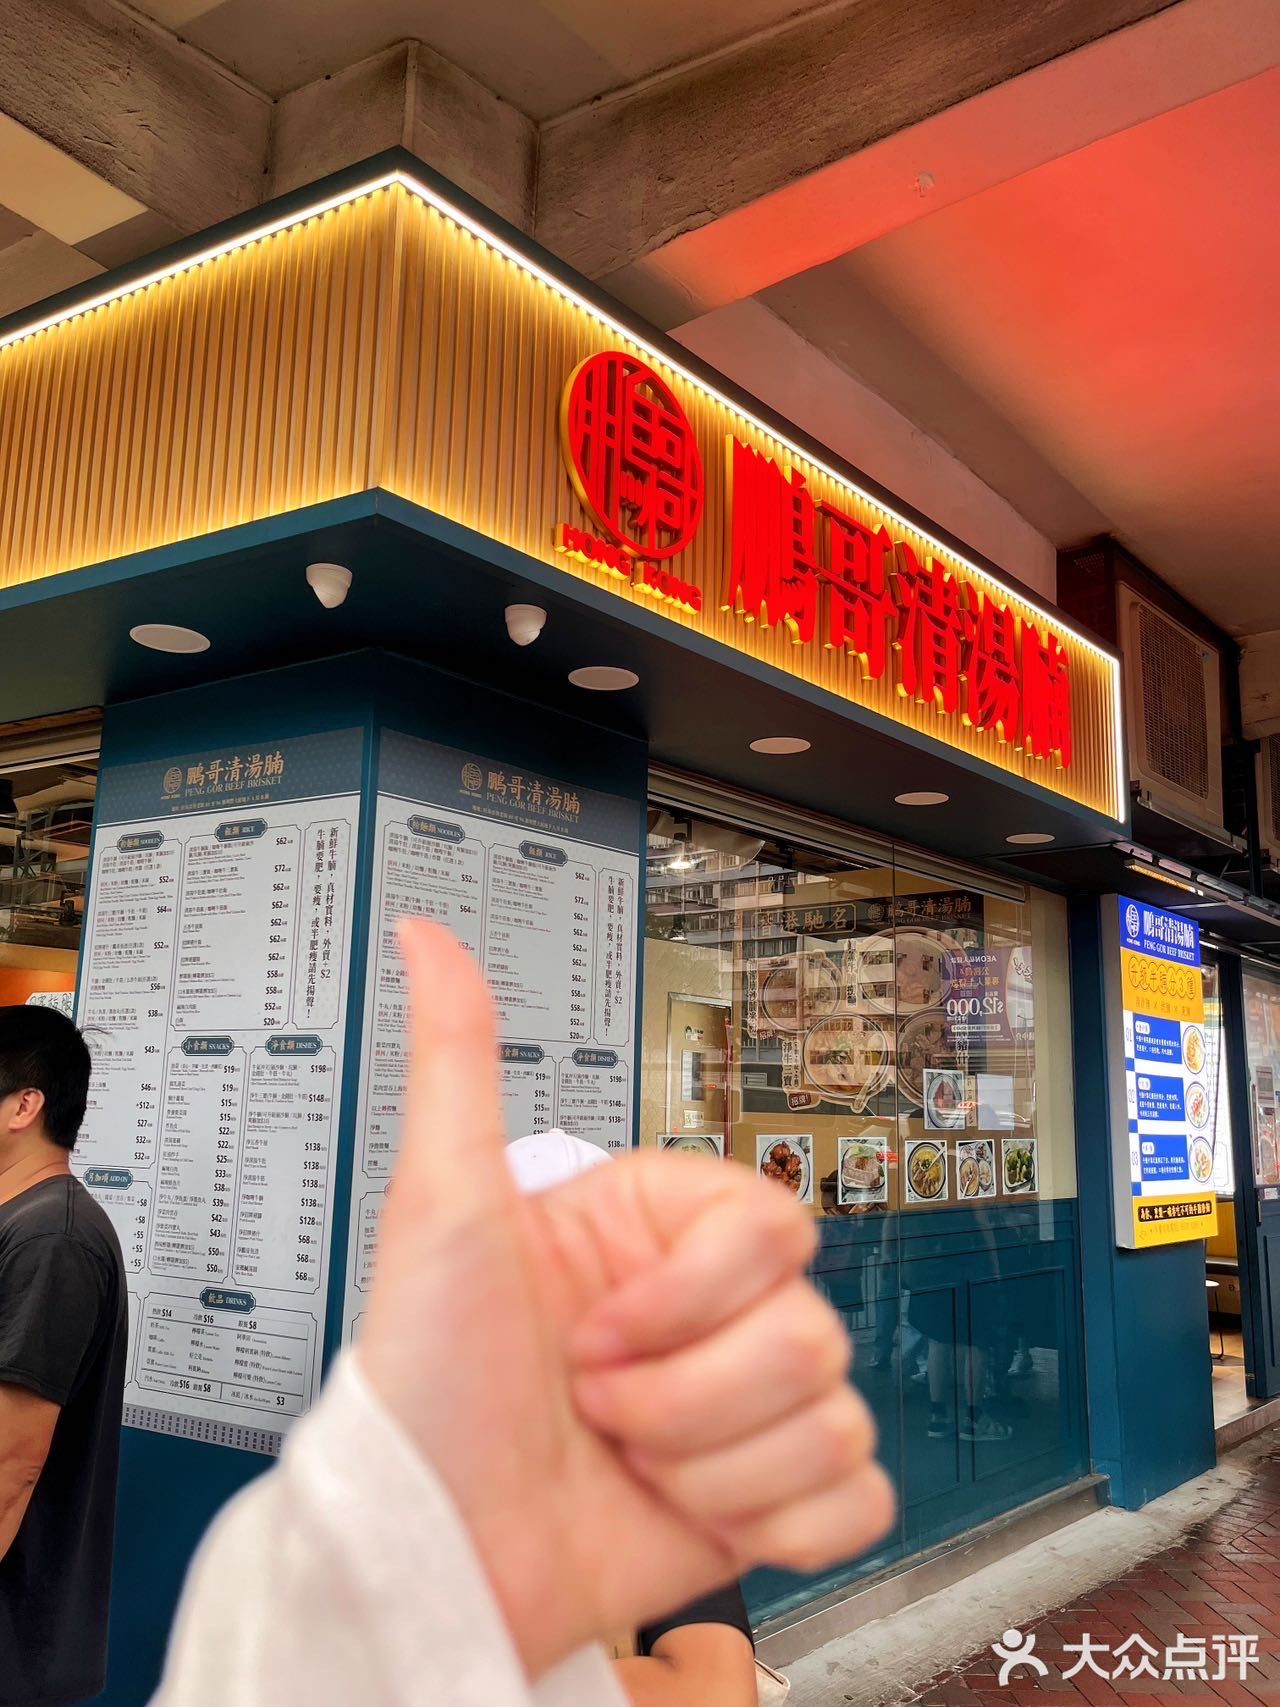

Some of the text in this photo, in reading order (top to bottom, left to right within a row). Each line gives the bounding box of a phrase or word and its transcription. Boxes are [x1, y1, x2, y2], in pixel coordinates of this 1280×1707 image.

[557, 522, 703, 614] HONG KONG
[727, 434, 1072, 769] 鵬哥清湯腩
[187, 751, 285, 786] 鵬哥清湯腩
[185, 776, 283, 796] PENG GOR BEEF BRISKET
[488, 771, 581, 814] 鵬哥清湯腩
[486, 792, 508, 805] PENG
[508, 799, 526, 809] GOR
[527, 803, 547, 814] BEEF
[548, 809, 580, 823] BRISKET
[500, 1046, 519, 1058] 食類
[311, 1065, 326, 1073] $198
[309, 1094, 324, 1102] $148
[307, 1113, 323, 1121] $138
[305, 1143, 320, 1151] $138
[304, 1161, 320, 1170] $138
[302, 1179, 318, 1188] $138
[301, 1198, 317, 1207] $138
[299, 1216, 315, 1225] $128
[298, 1235, 310, 1244] $68
[296, 1254, 309, 1262] $68
[295, 1272, 307, 1280] $68
[225, 1296, 247, 1306] DRINKS
[162, 1309, 172, 1317] $14
[204, 1315, 214, 1323] $16
[249, 1321, 257, 1329] $8
[180, 1380, 190, 1389] $16
[203, 1384, 211, 1392] $8
[276, 1396, 284, 1405] $3
